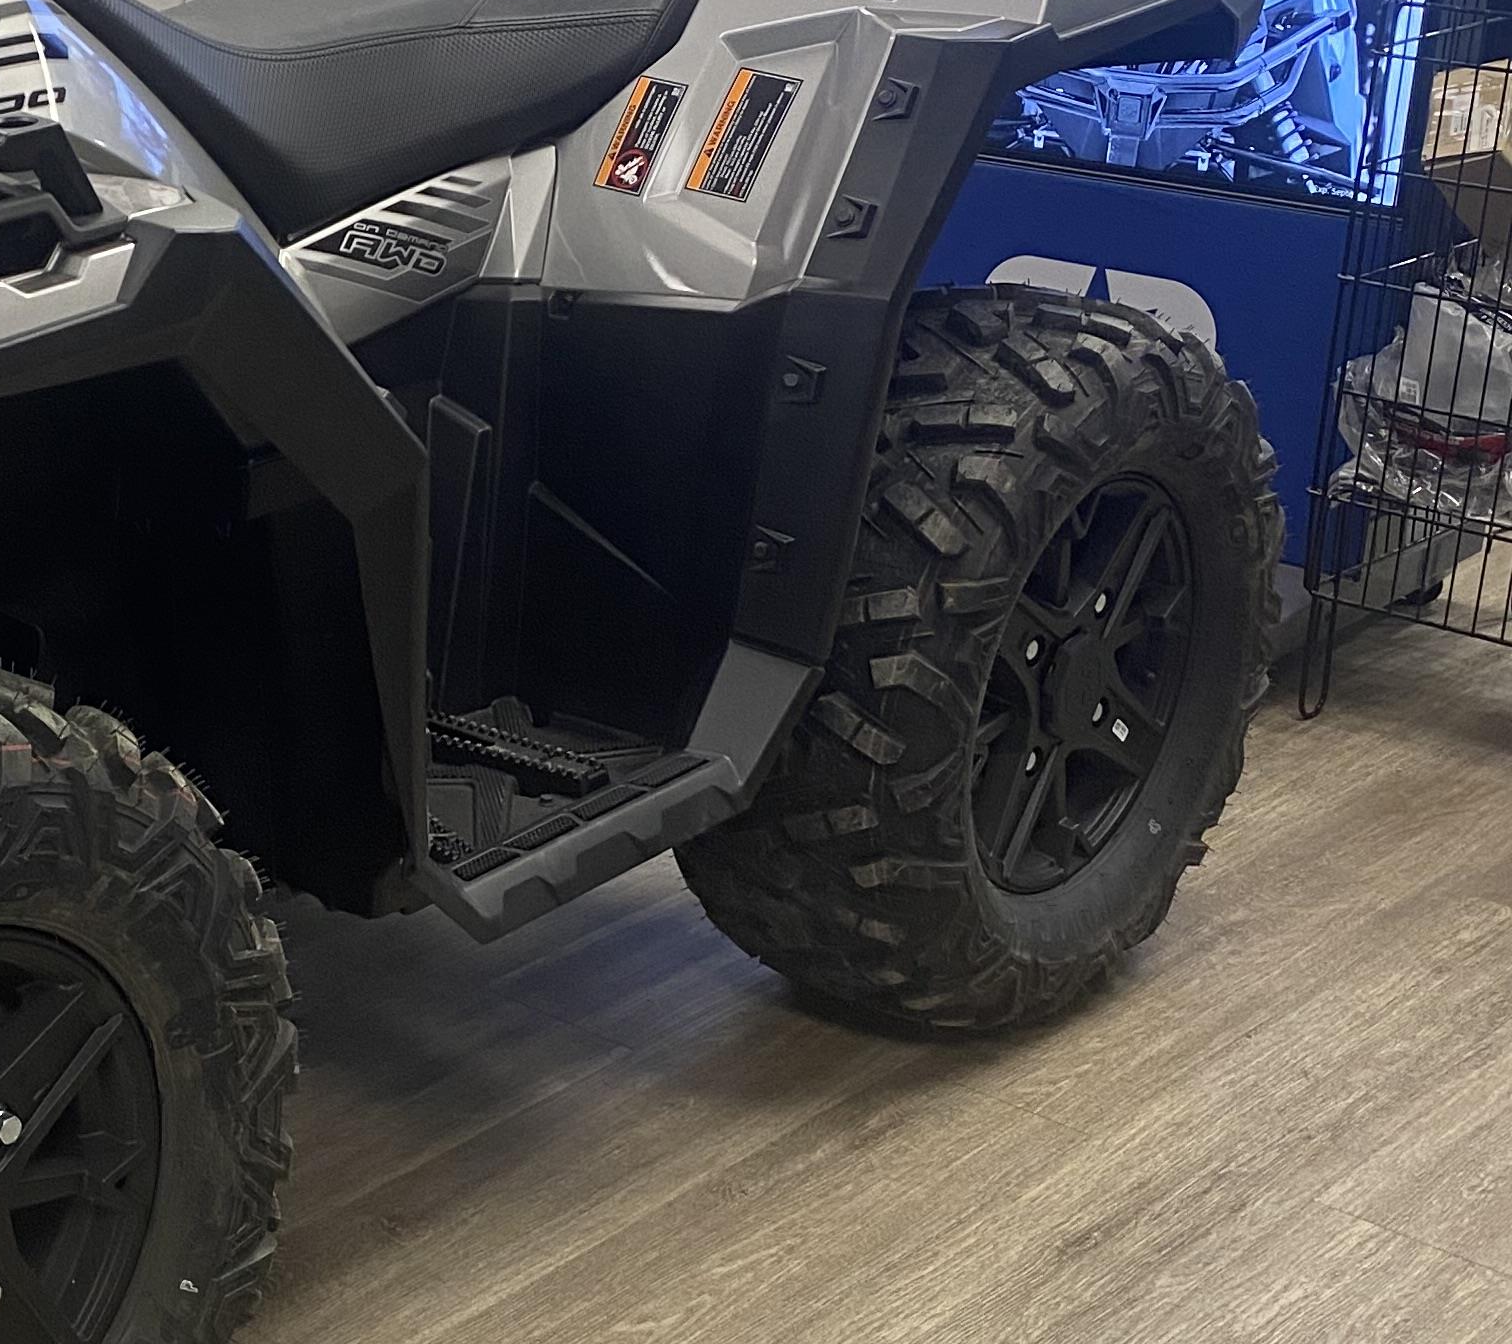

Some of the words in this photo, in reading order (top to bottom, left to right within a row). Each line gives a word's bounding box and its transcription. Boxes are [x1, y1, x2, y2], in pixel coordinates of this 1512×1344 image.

[615, 103, 637, 151] WARNING
[708, 100, 737, 151] WARNING
[339, 230, 447, 276] AWD
